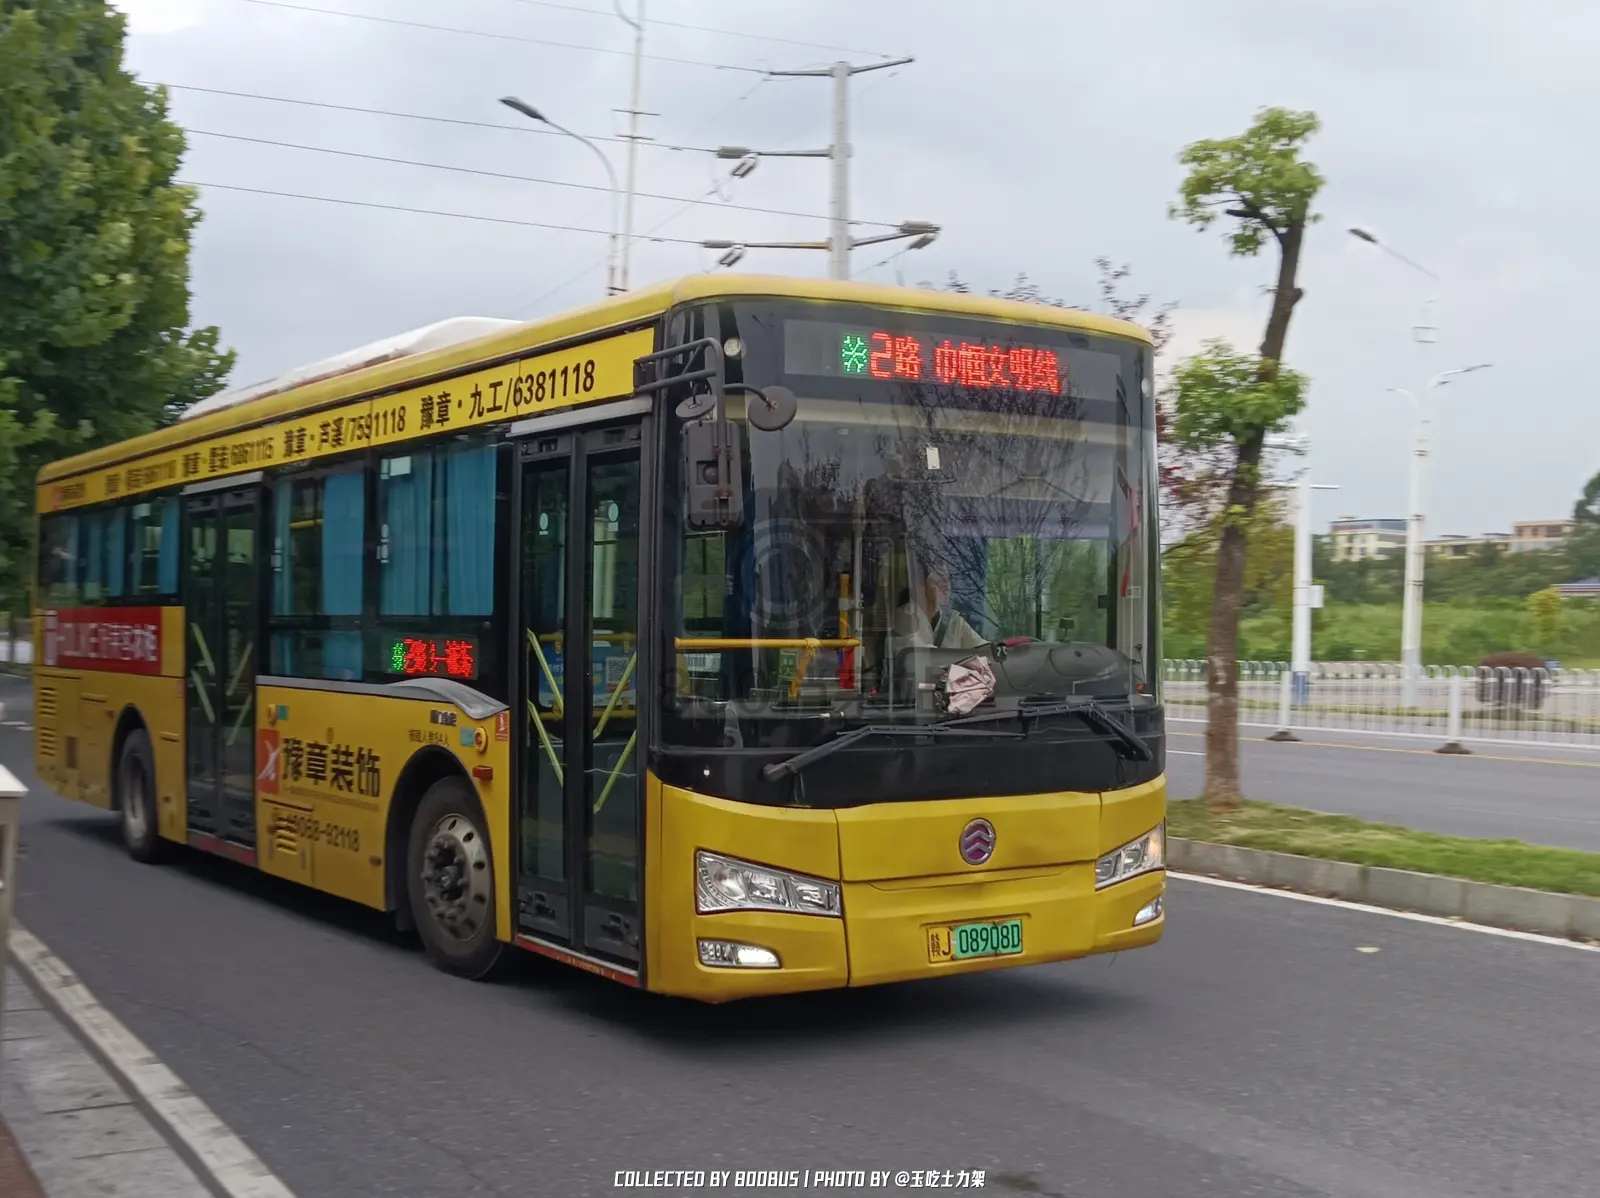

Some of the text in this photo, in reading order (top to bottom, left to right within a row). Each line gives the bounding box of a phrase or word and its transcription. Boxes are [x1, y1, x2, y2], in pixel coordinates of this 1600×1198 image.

[869, 331, 923, 380] 2路
[282, 737, 381, 798] 豫章装饰
[958, 923, 1021, 954] 08908D
